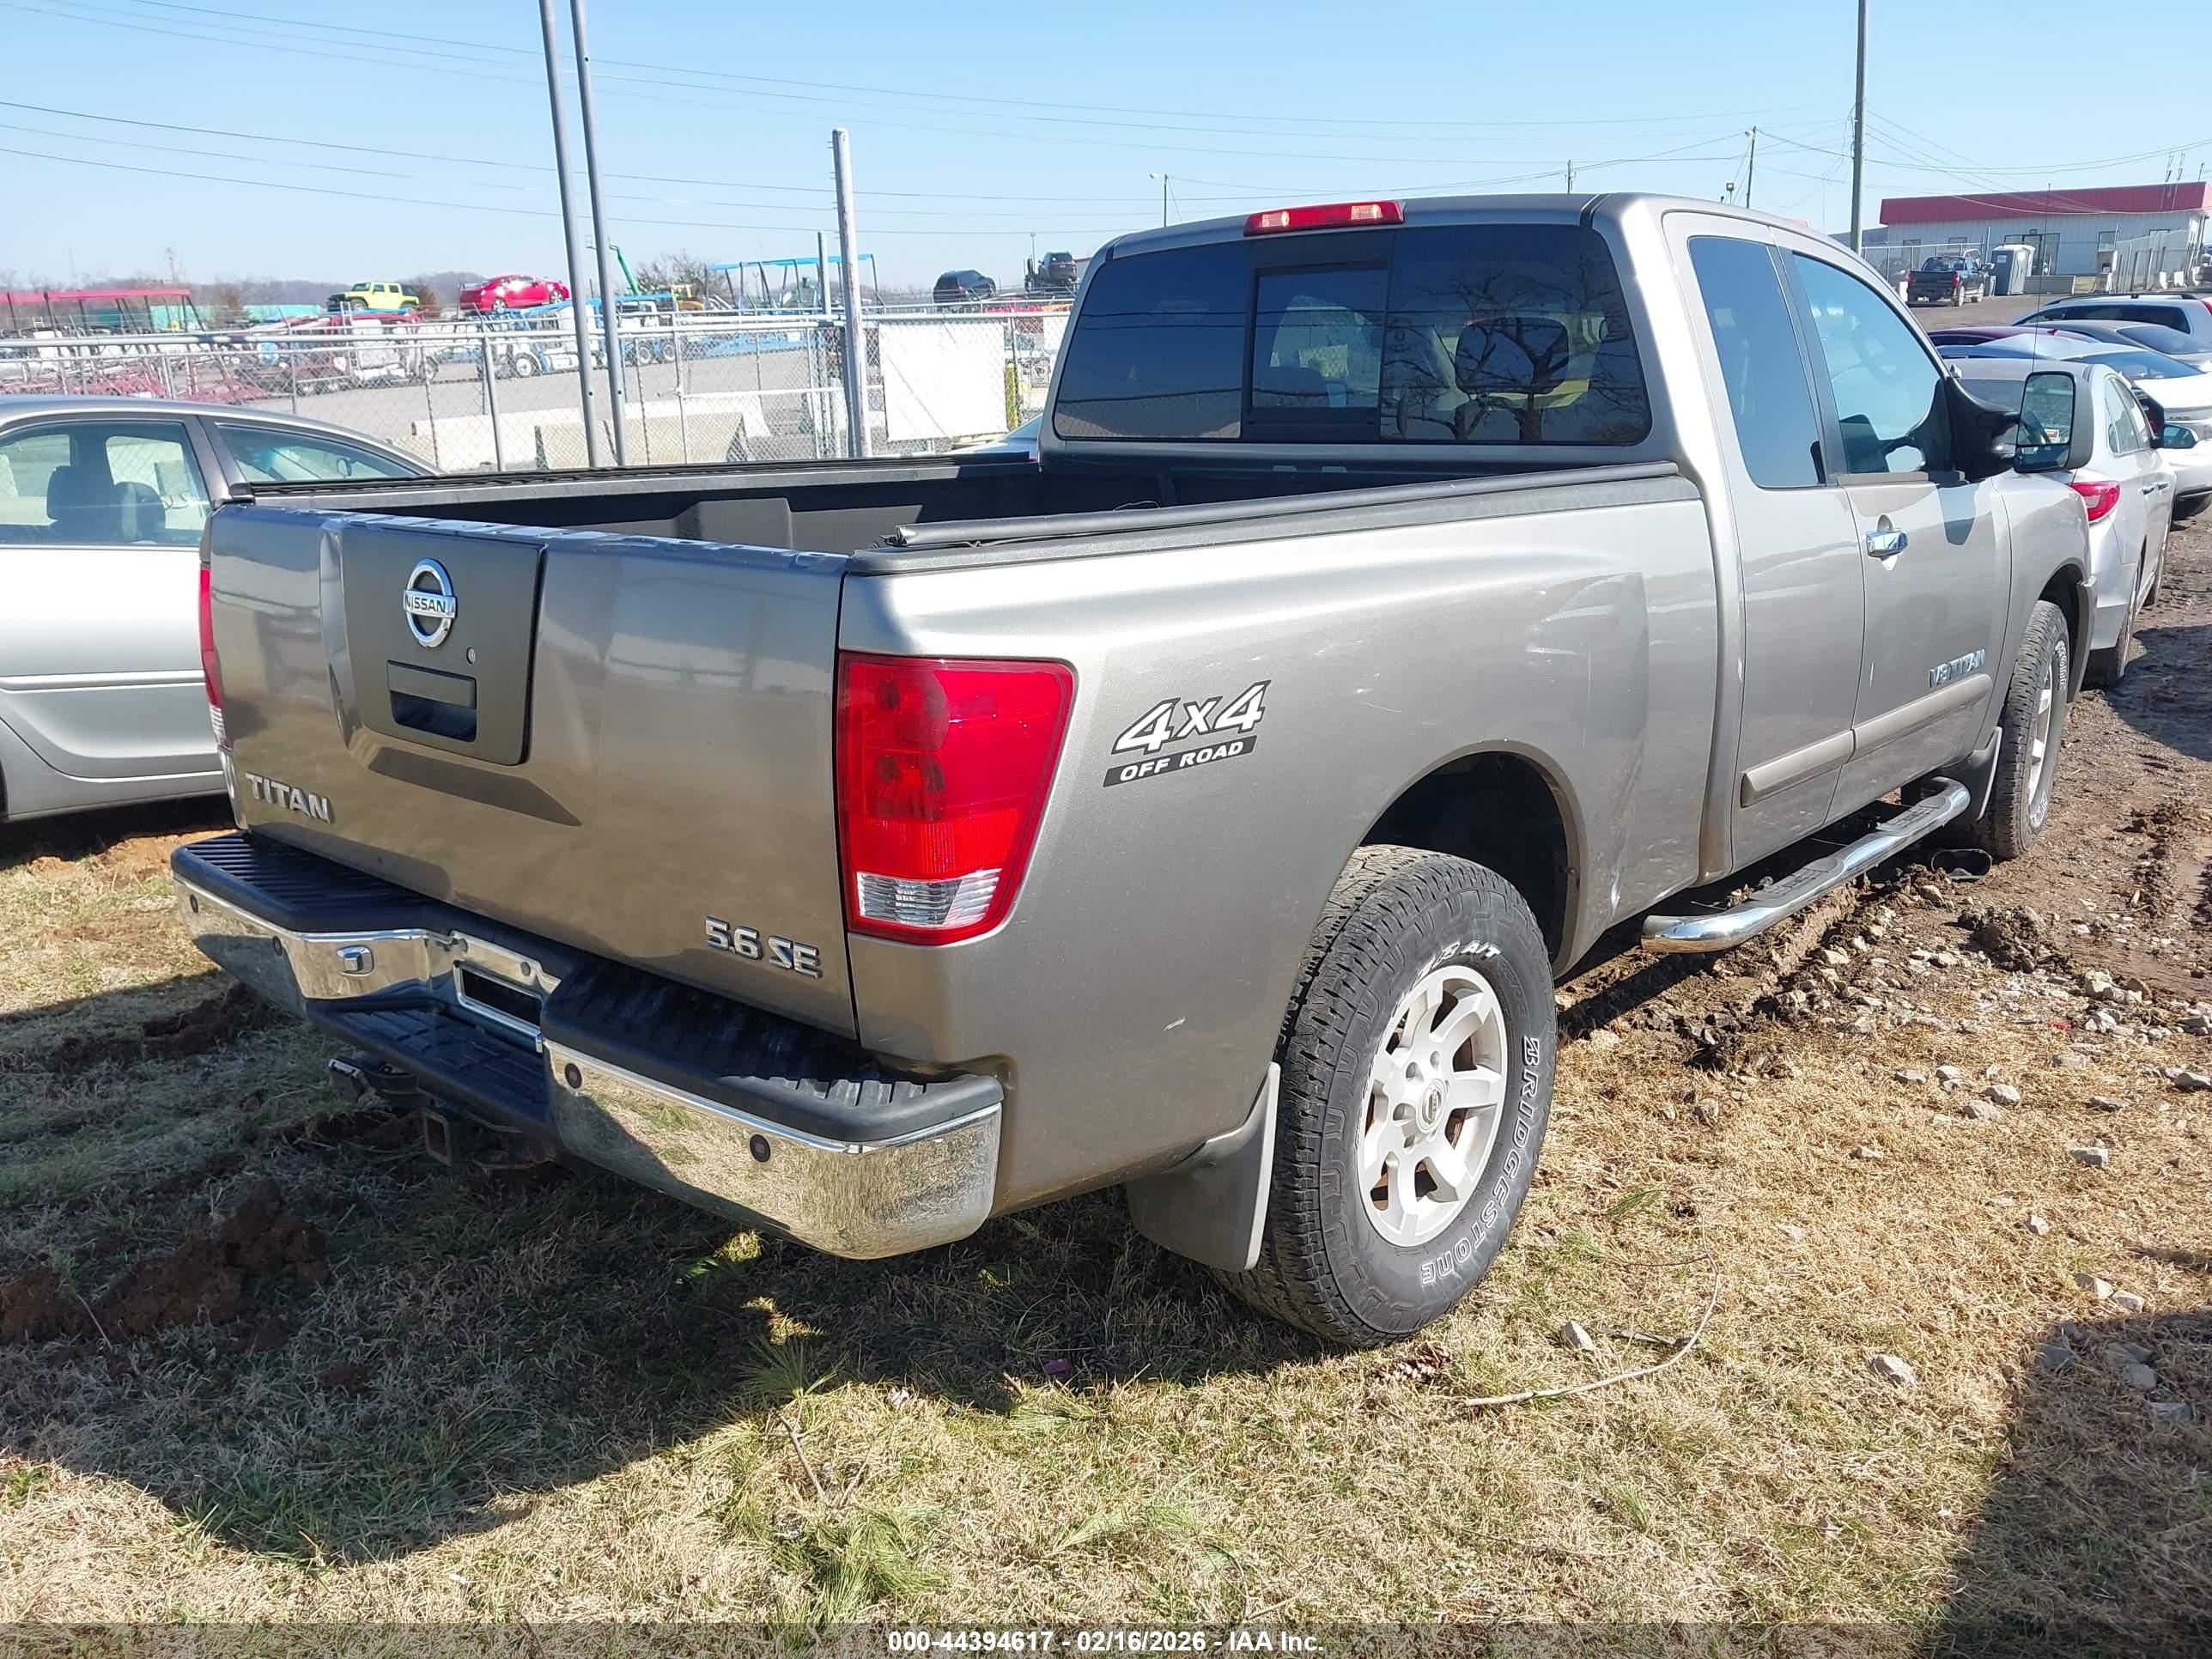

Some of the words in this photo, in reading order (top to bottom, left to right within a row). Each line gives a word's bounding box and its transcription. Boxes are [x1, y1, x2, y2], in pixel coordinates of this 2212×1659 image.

[404, 593, 447, 613] NISSAN
[1119, 757, 1171, 782] OFF
[1178, 740, 1244, 768] ROAD
[245, 771, 332, 824] TITAN
[705, 916, 763, 960] 5.6
[768, 935, 822, 979] SE
[1420, 1035, 1540, 1285] BRIDGESTONE
